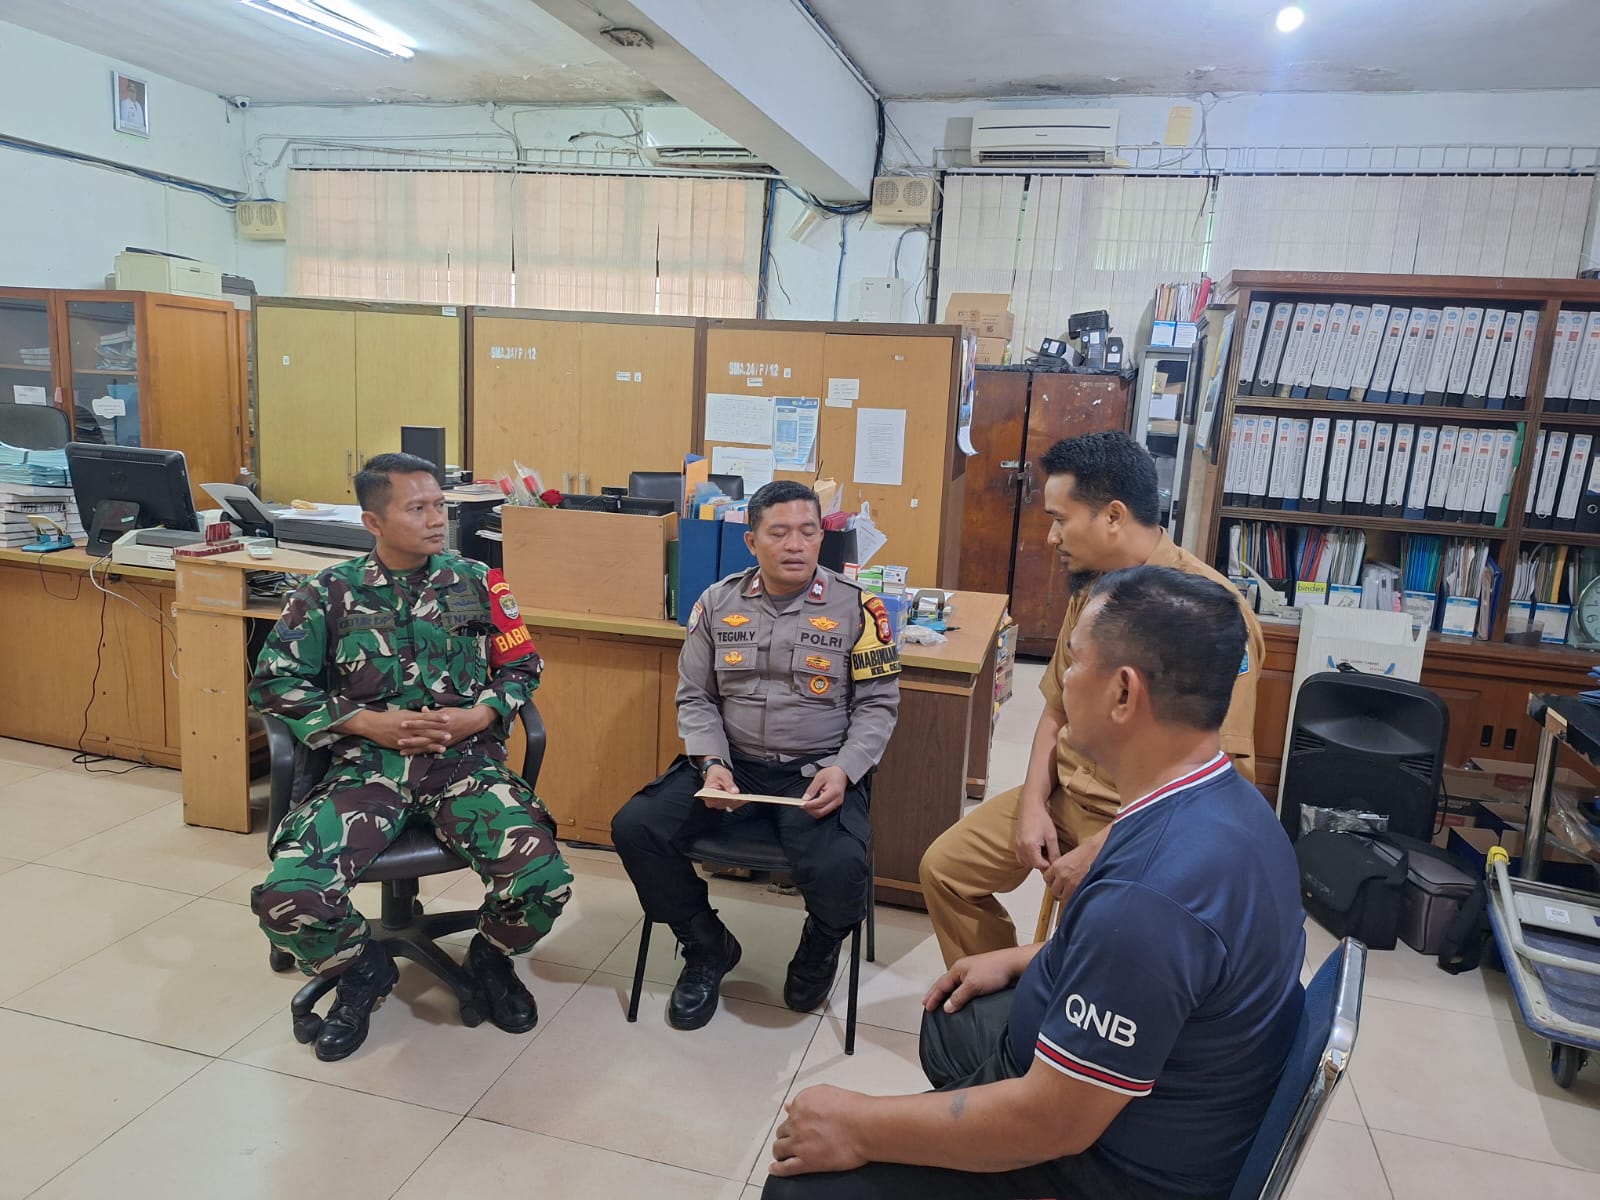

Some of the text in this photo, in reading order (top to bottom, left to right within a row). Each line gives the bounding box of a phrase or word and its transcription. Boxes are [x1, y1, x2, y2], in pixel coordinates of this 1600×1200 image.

[1297, 582, 1326, 593] bindex
[717, 631, 756, 643] TEGUH.Y
[800, 631, 843, 649] POLRI
[1065, 993, 1138, 1048] QNB
